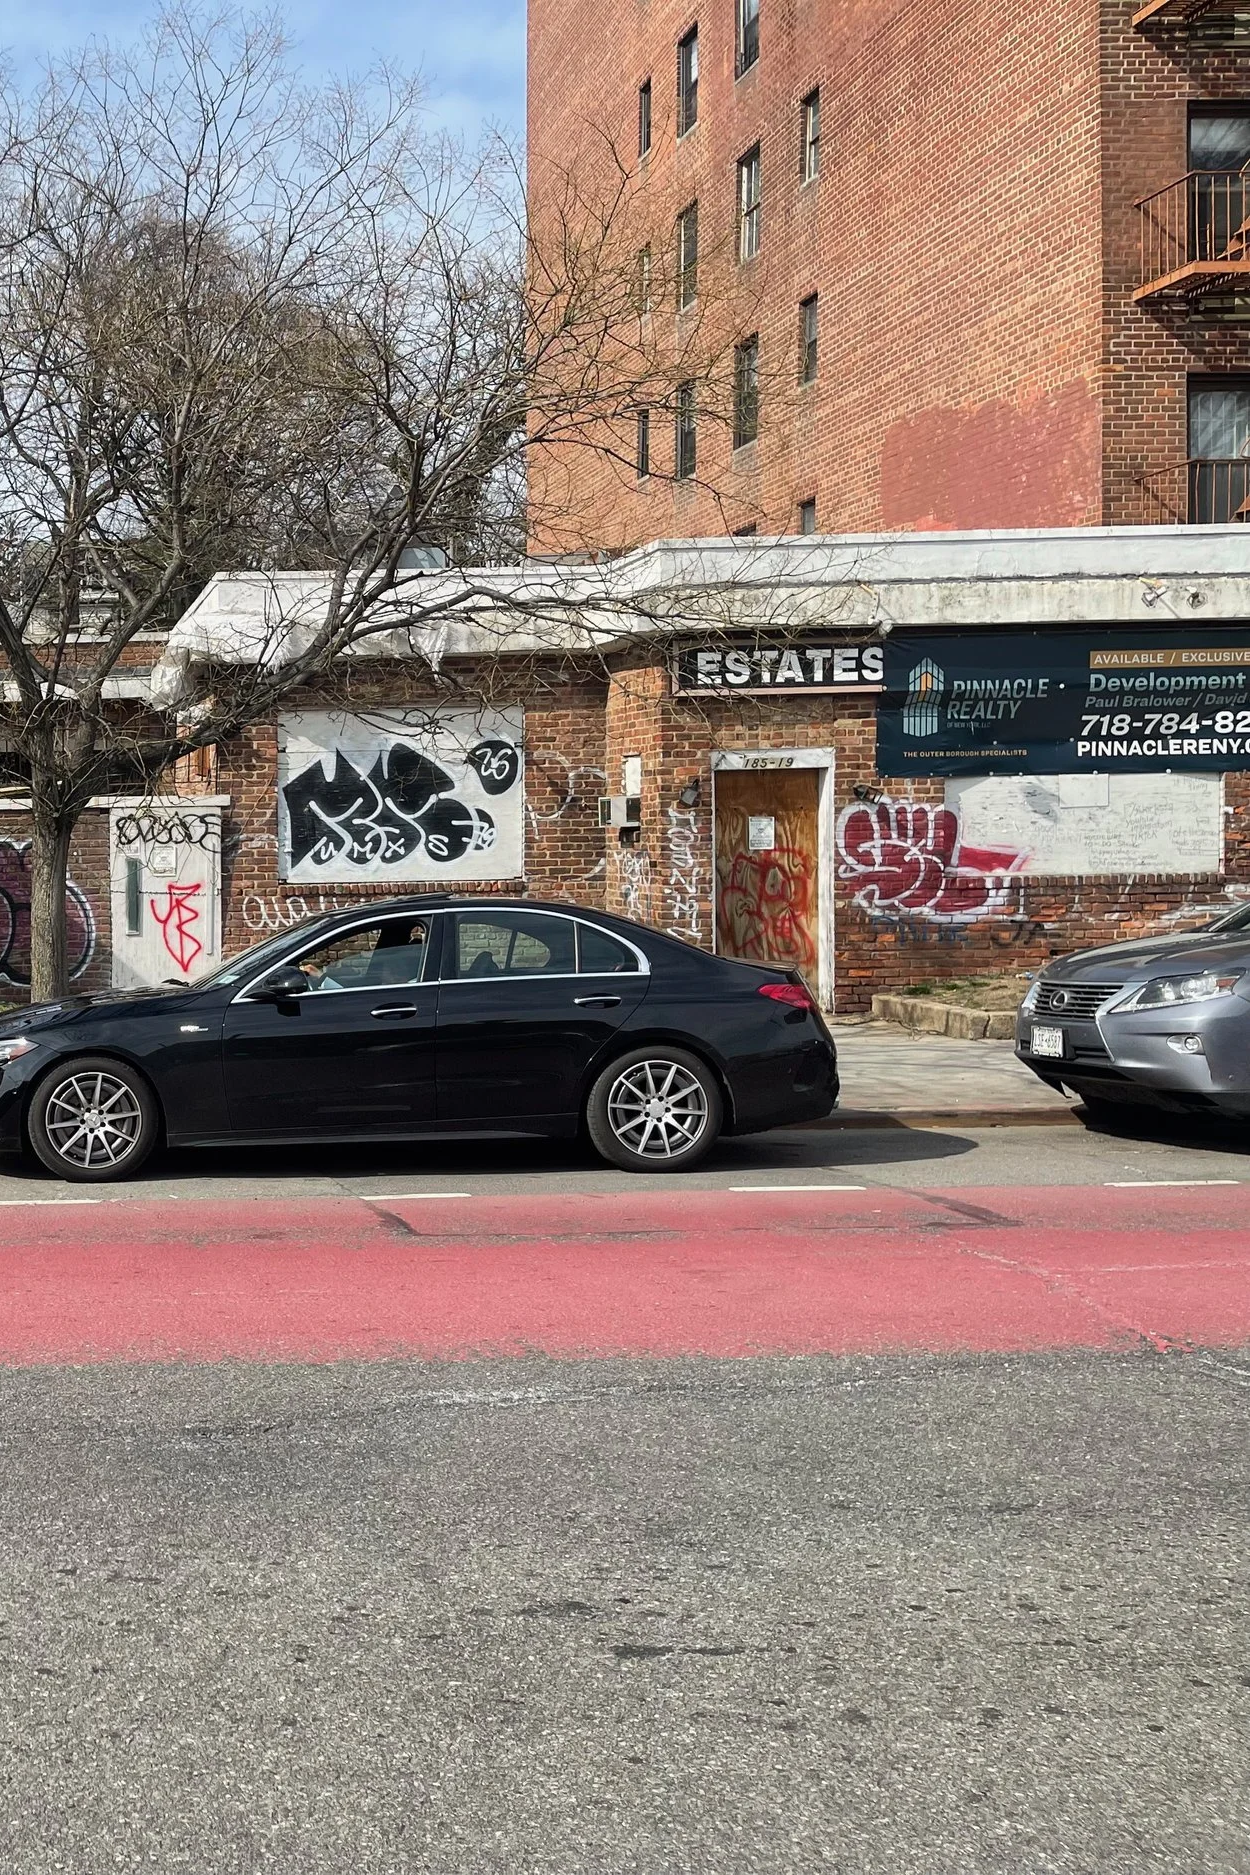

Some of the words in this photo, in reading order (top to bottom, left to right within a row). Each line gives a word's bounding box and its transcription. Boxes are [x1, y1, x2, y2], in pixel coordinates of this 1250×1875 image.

[697, 647, 884, 685] ESTATES
[1094, 653, 1165, 665] AVAILABLE
[1181, 651, 1250, 663] EXCLUSIVE
[951, 678, 1050, 699] PINNACLE
[1089, 671, 1247, 694] Development
[1085, 695, 1119, 708] Paul
[1122, 694, 1192, 708] Bralower
[1204, 692, 1248, 706] David
[947, 700, 1022, 720] REALTY
[981, 749, 1027, 757] SPECIALISTS
[743, 756, 794, 769] 185-19
